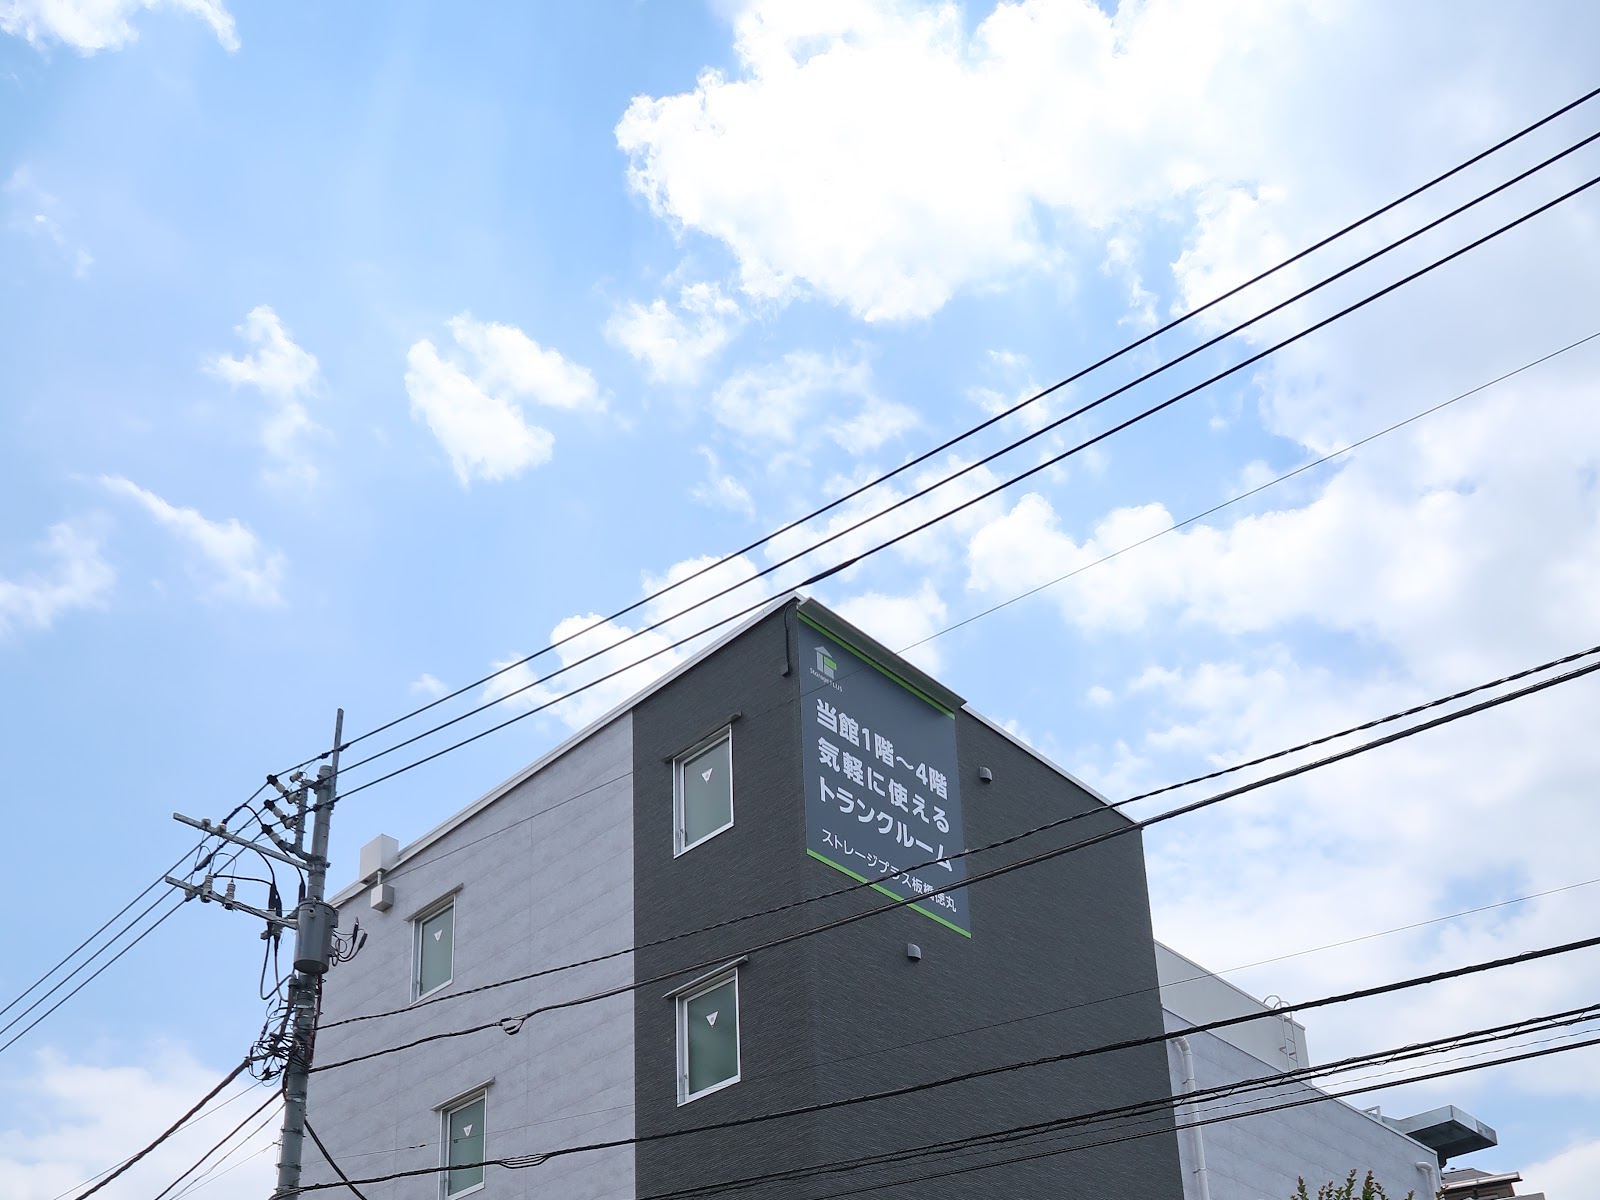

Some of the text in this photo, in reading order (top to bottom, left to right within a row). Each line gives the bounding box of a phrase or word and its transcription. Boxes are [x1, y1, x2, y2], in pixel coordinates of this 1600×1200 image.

[817, 737, 950, 833] 気軽に使える
[820, 776, 953, 872] トランクルーム
